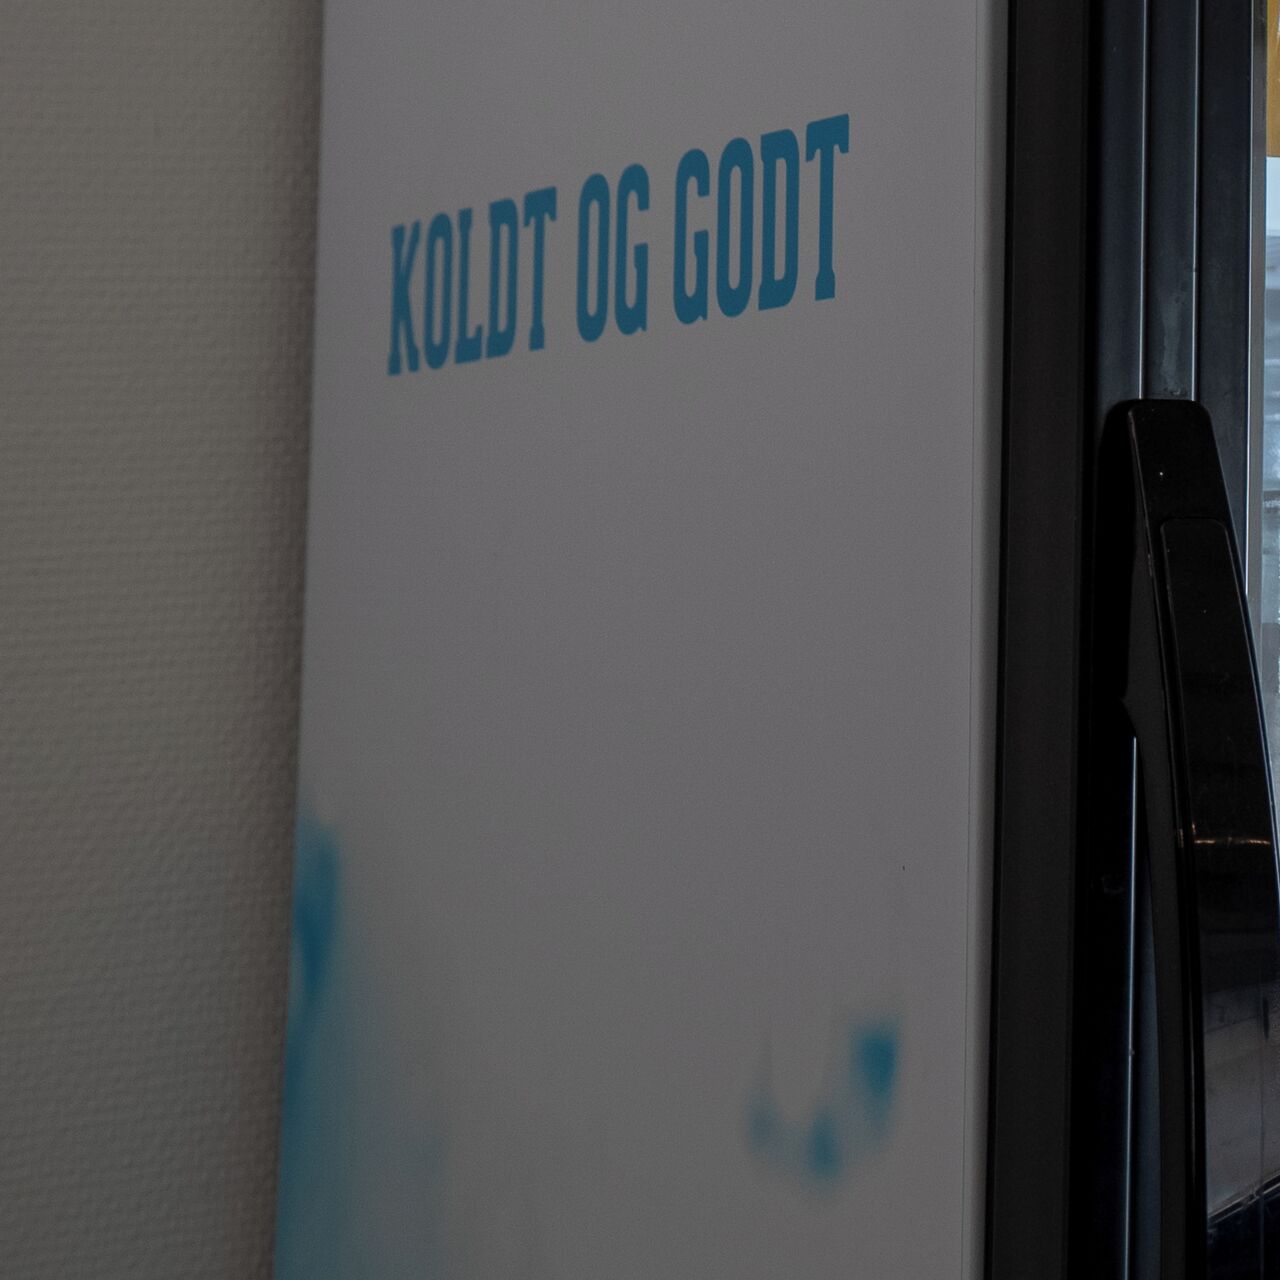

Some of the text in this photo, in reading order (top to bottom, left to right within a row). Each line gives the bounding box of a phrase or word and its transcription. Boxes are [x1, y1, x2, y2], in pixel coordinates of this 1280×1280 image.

[388, 113, 849, 376] KOLDT OG GODT
